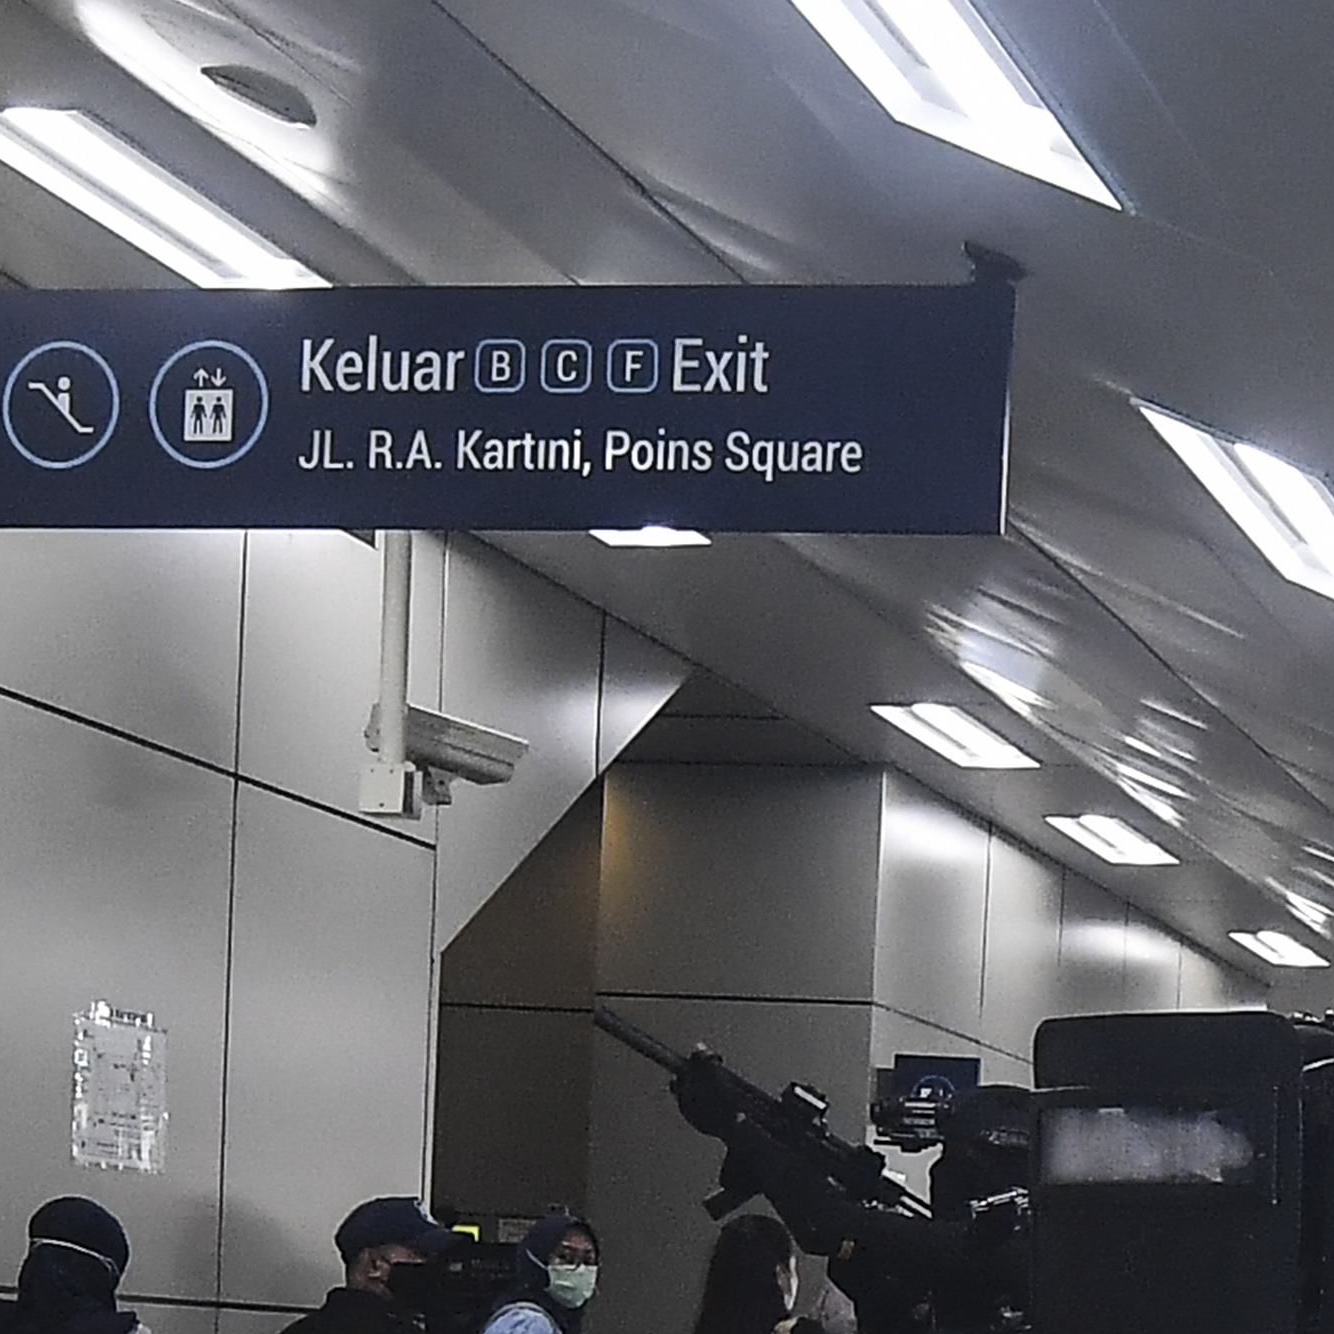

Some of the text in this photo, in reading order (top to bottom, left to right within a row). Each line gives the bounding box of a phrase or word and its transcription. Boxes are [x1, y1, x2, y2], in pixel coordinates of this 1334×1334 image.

[301, 334, 770, 392] Keluar B C F Exit
[298, 428, 863, 482] JL. R.A. Kartini, Poins Square
